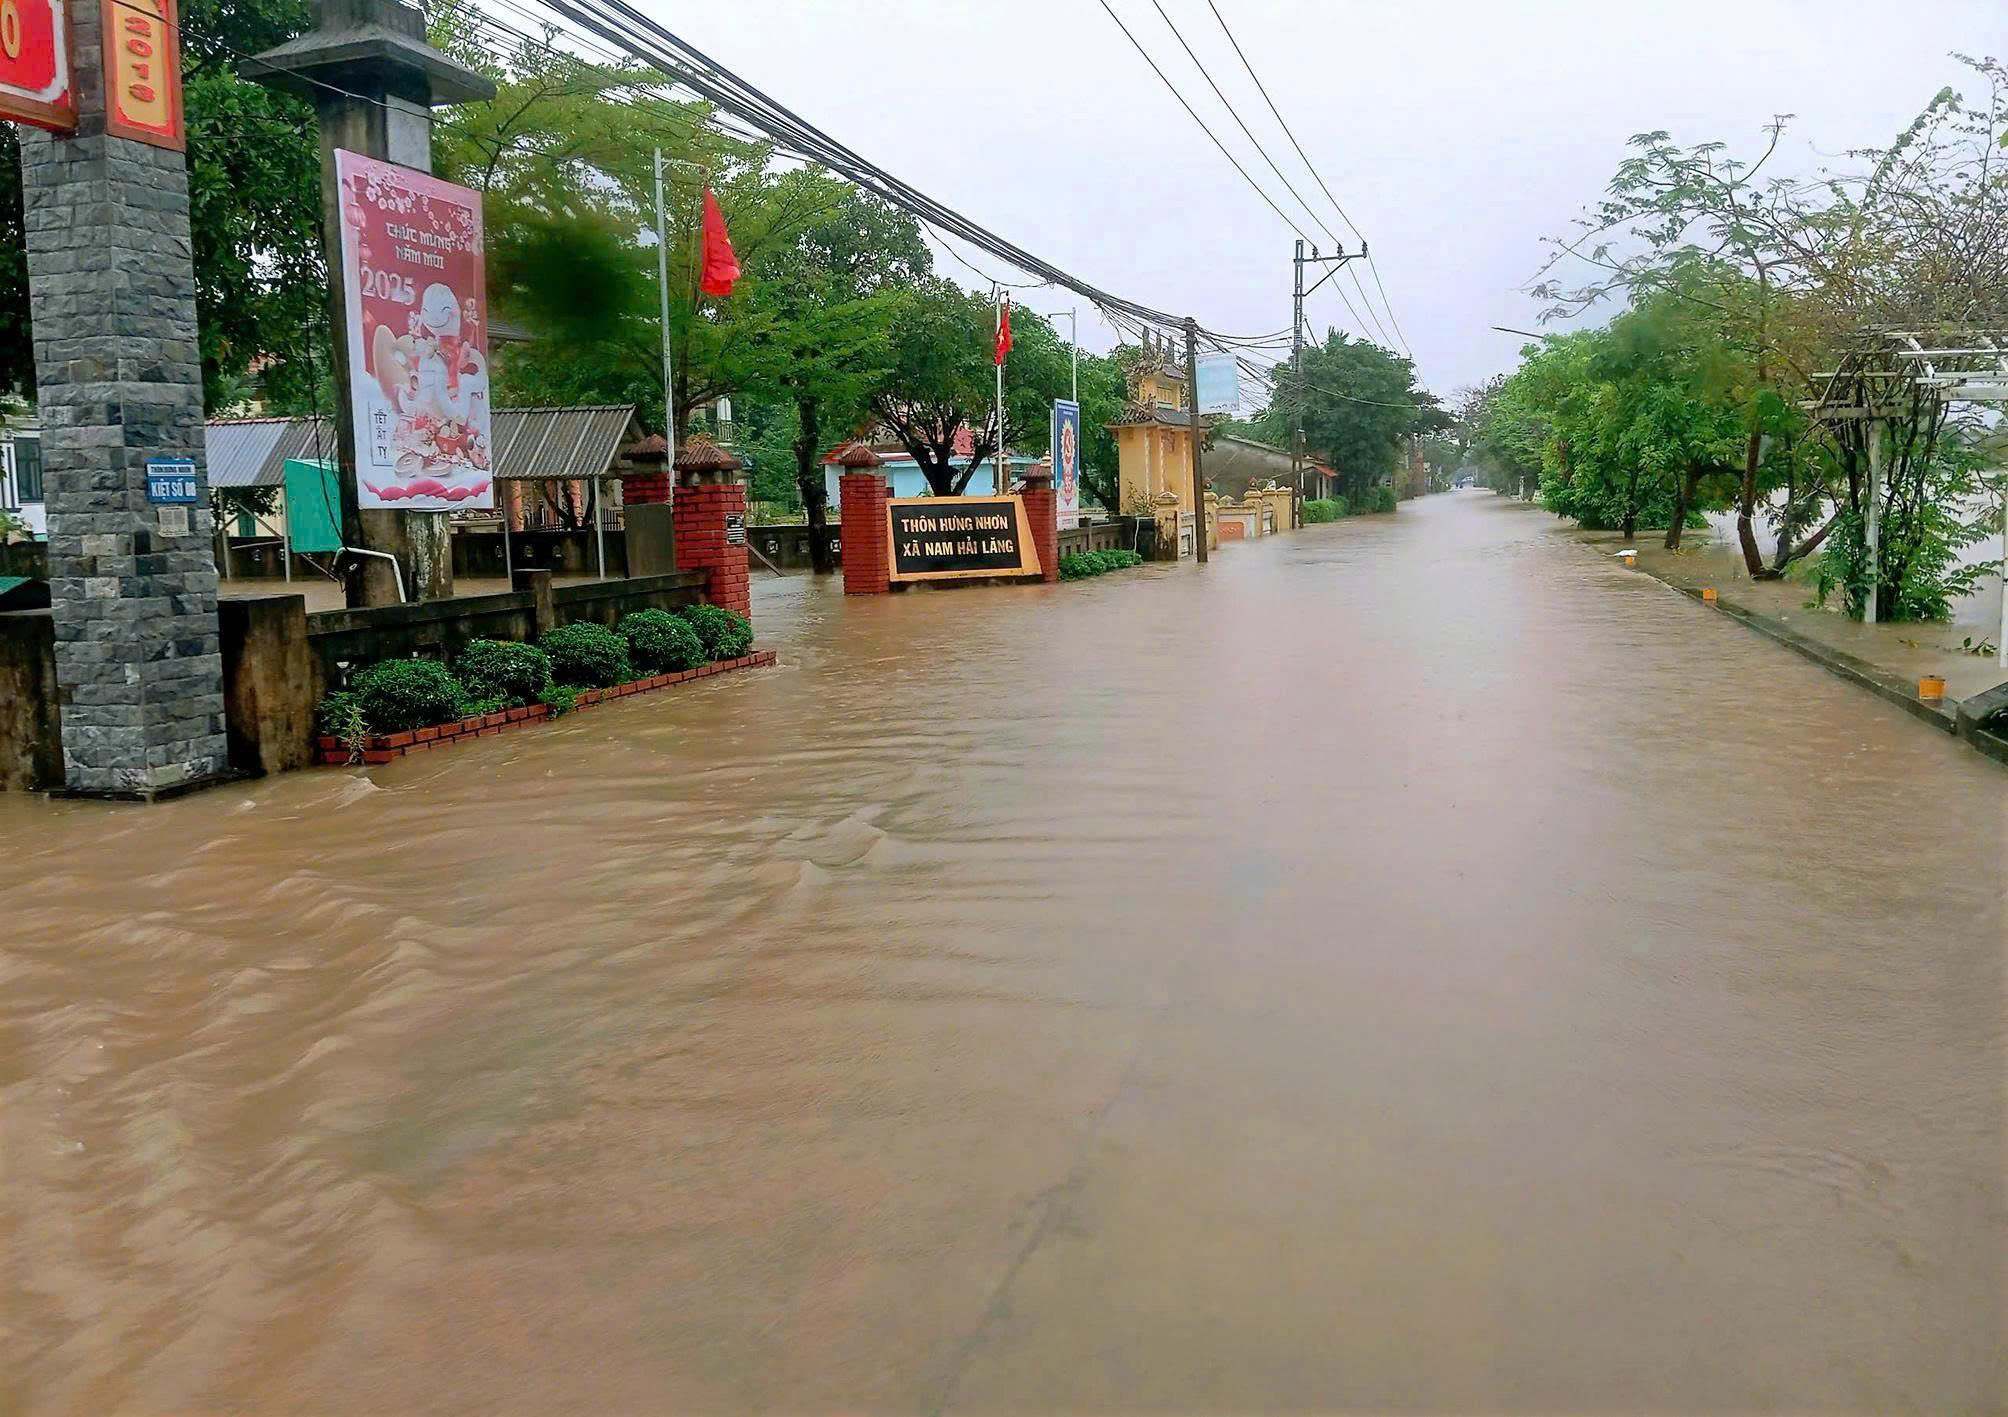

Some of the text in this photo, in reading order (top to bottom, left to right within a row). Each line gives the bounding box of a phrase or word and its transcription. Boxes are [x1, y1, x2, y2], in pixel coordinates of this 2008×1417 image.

[385, 222, 417, 243] CHÚC
[395, 243, 421, 265] NĂM
[360, 265, 416, 305] 2025
[151, 478, 170, 500] KIỆT
[171, 478, 184, 497] SỐ
[901, 514, 1008, 533] THÔN HƯNG NHƠN
[903, 536, 1014, 557] XÃ NAM HẢI LĂNG
